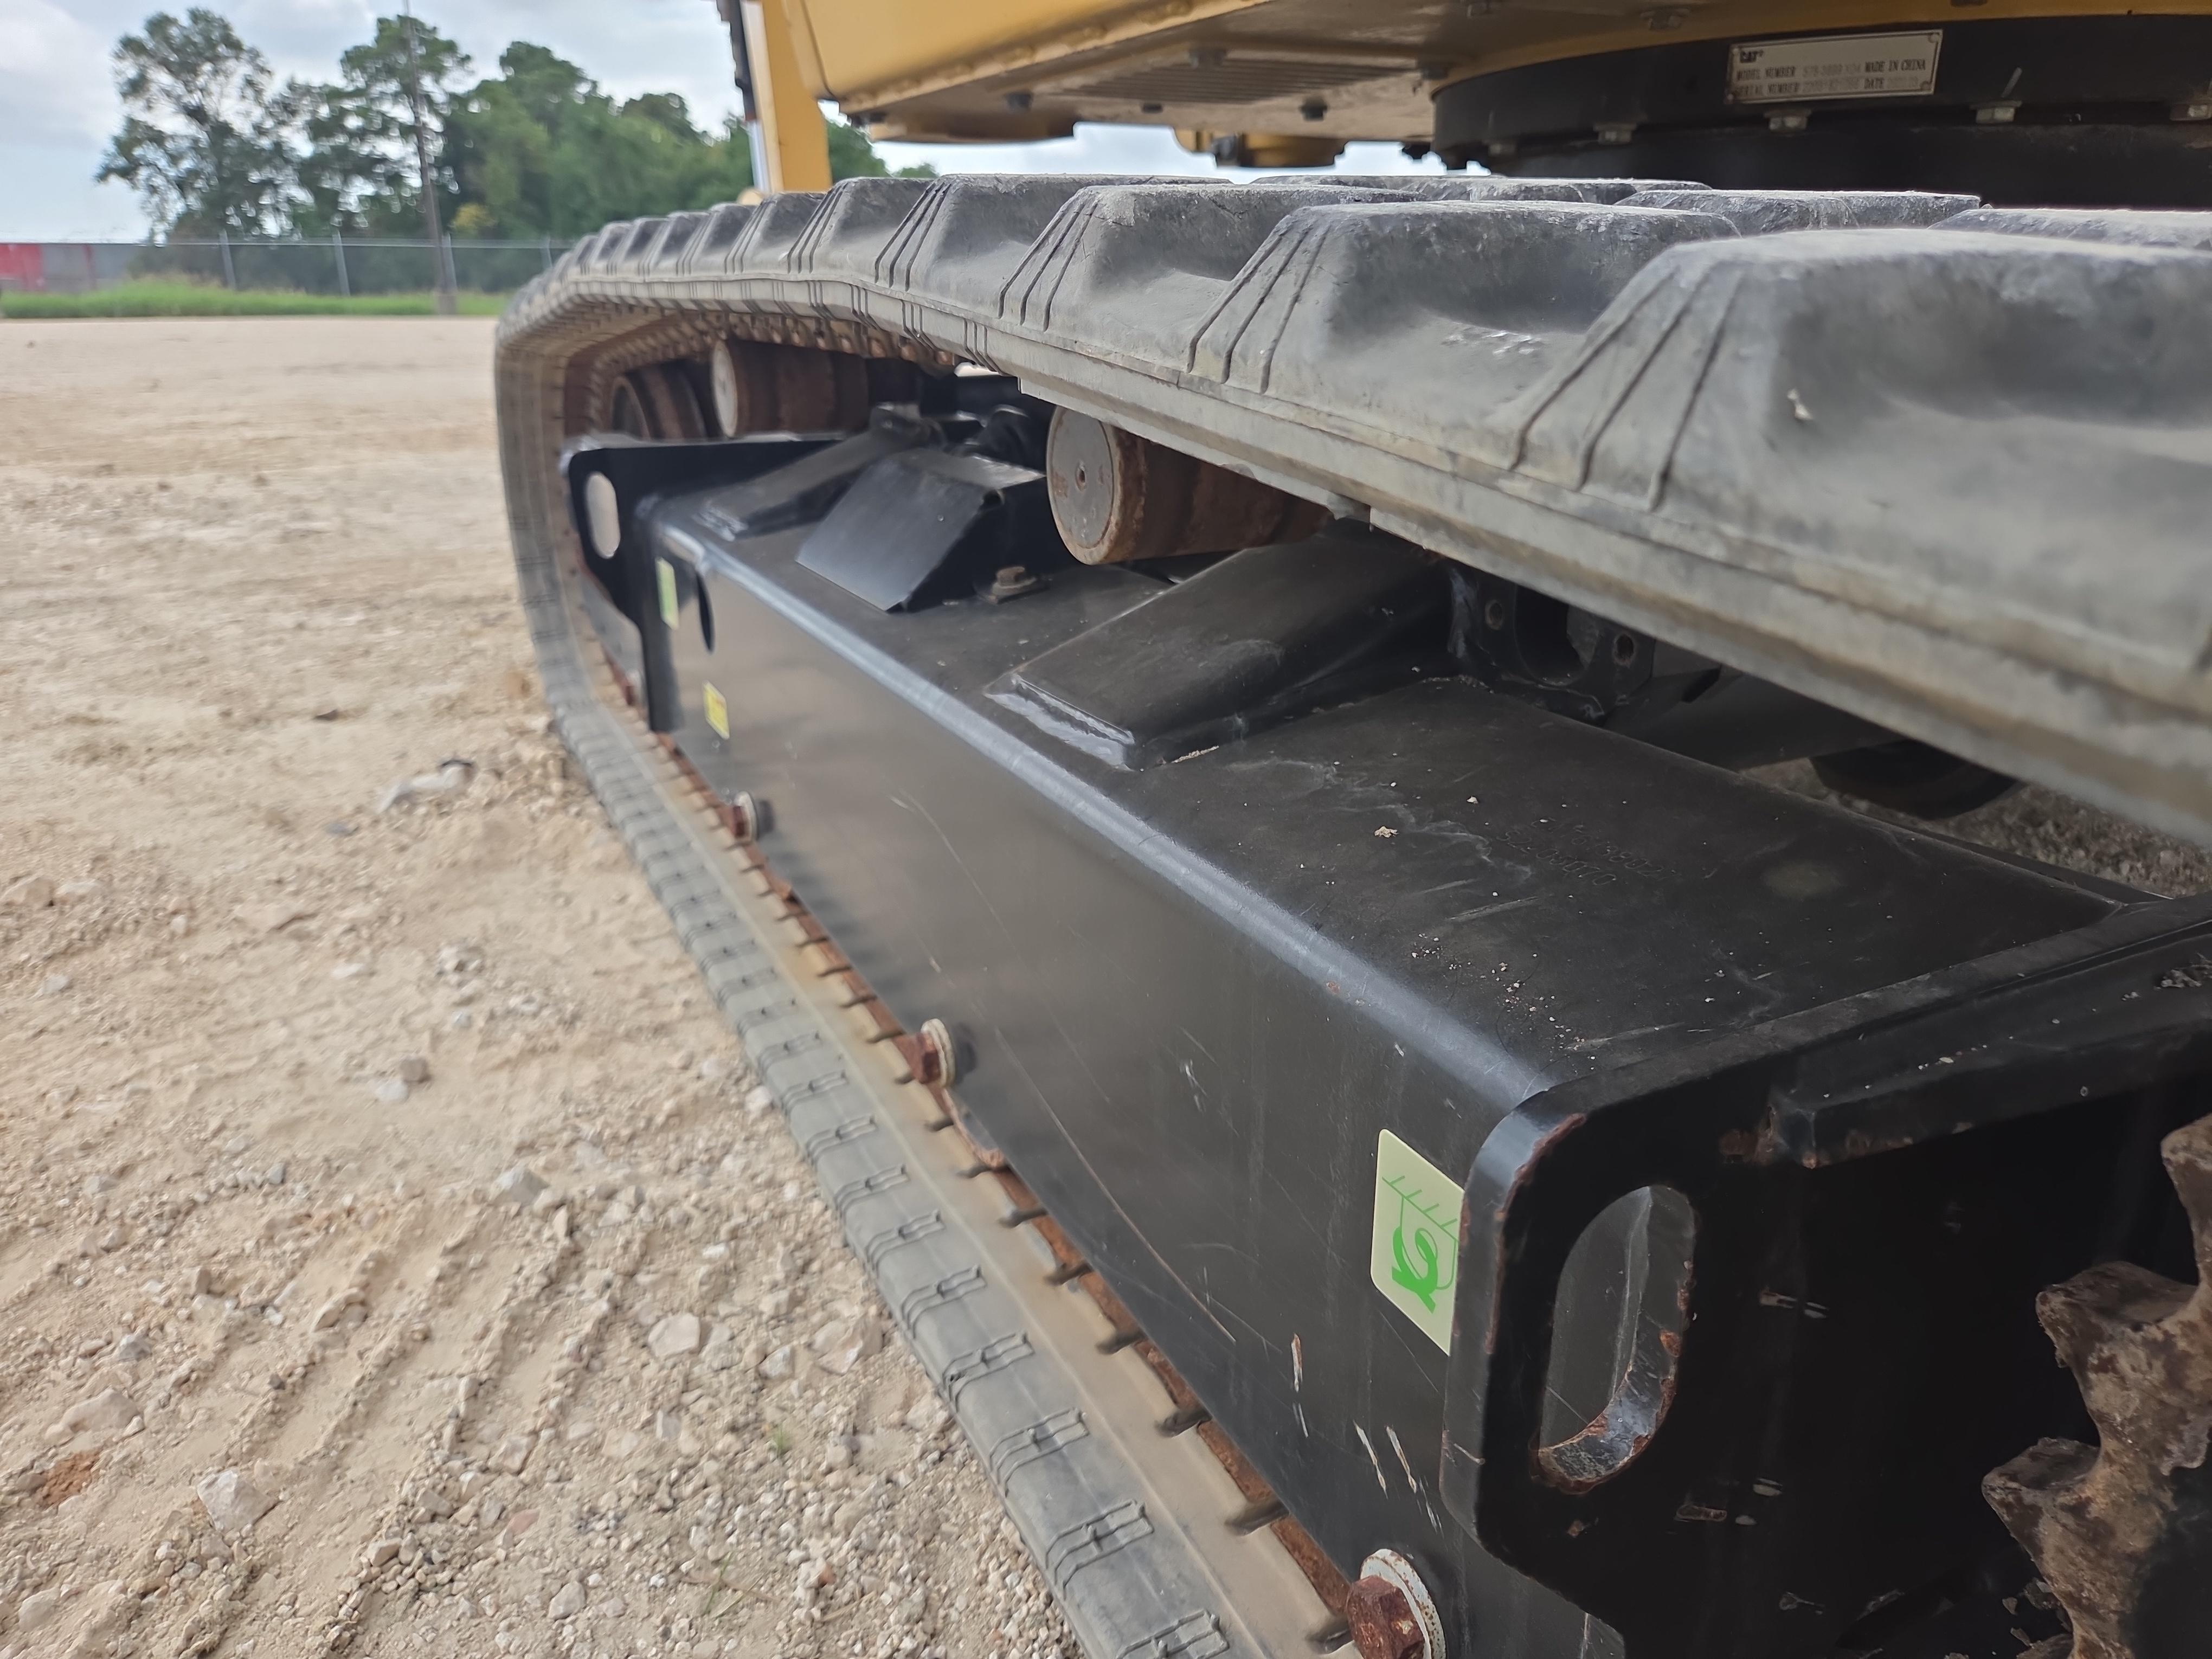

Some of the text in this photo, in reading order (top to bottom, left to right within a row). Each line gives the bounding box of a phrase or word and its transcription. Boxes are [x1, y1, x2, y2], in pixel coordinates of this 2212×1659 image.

[1864, 61, 1885, 72] MADE
[1888, 60, 1899, 71] IN
[1901, 58, 1926, 71] CHINA
[1765, 66, 1796, 78] NUMBER
[1767, 82, 1799, 93] NUMBER
[1864, 78, 1885, 89] DATE
